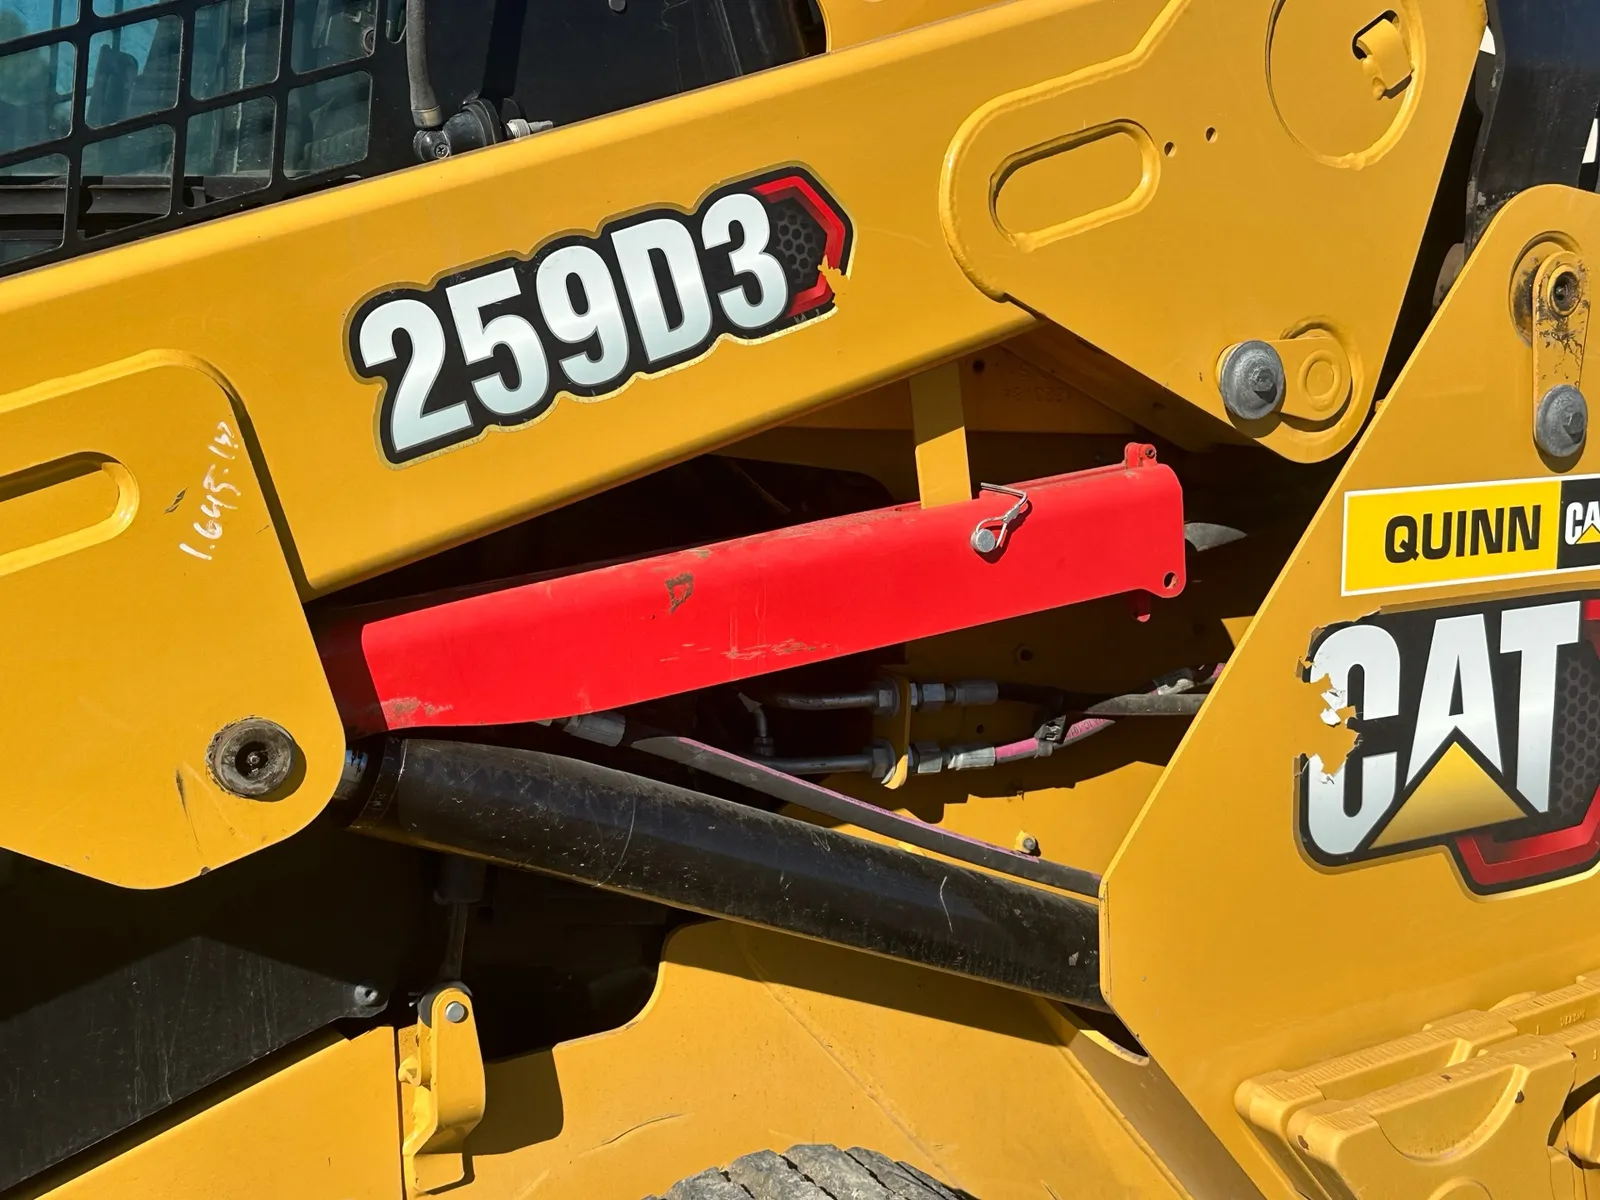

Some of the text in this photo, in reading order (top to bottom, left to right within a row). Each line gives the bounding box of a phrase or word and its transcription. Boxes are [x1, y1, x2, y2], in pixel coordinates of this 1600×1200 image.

[359, 192, 790, 453] 259D3
[1384, 501, 1600, 564] QUINN CA
[1307, 600, 1581, 854] CAT
